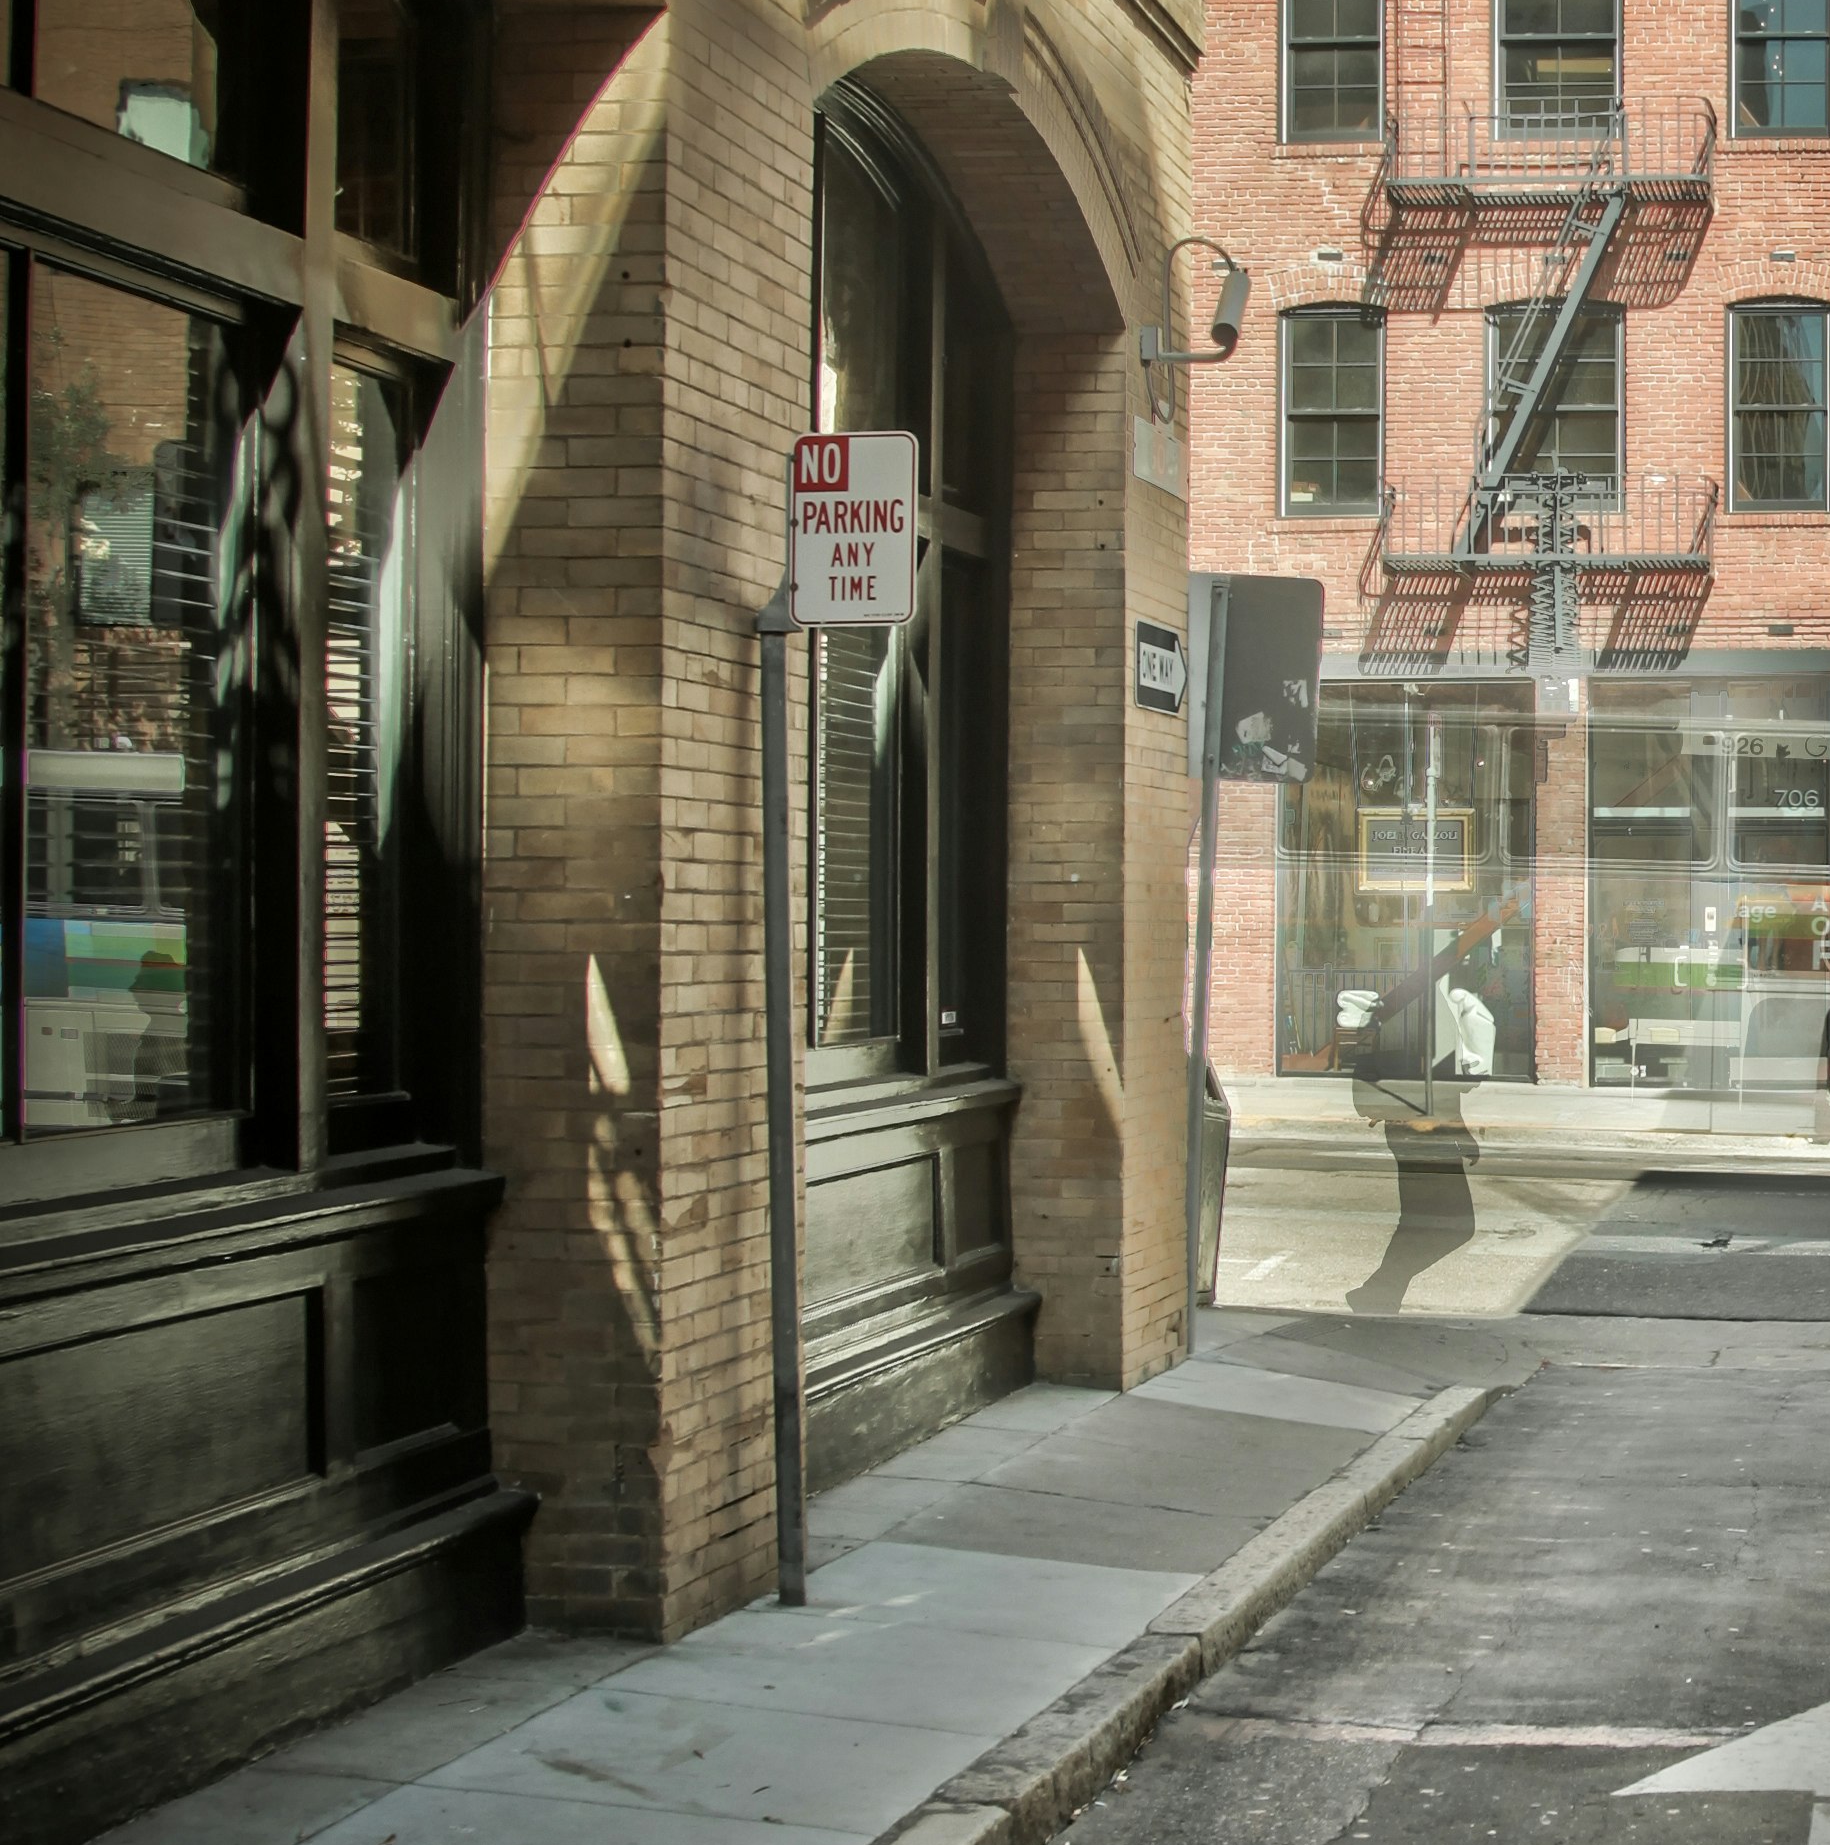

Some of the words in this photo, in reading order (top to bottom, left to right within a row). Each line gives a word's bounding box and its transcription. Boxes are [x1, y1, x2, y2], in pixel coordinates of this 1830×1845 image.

[801, 443, 841, 484] NO
[803, 499, 903, 534] PARKING
[831, 542, 875, 567] ANY
[829, 575, 877, 601] TIME
[1142, 650, 1157, 682] ONE
[1159, 655, 1173, 685] WAY
[1722, 737, 1764, 756] 926
[1774, 790, 1818, 807] 706
[1412, 831, 1458, 840] GAZOLI
[1811, 896, 1828, 912] A
